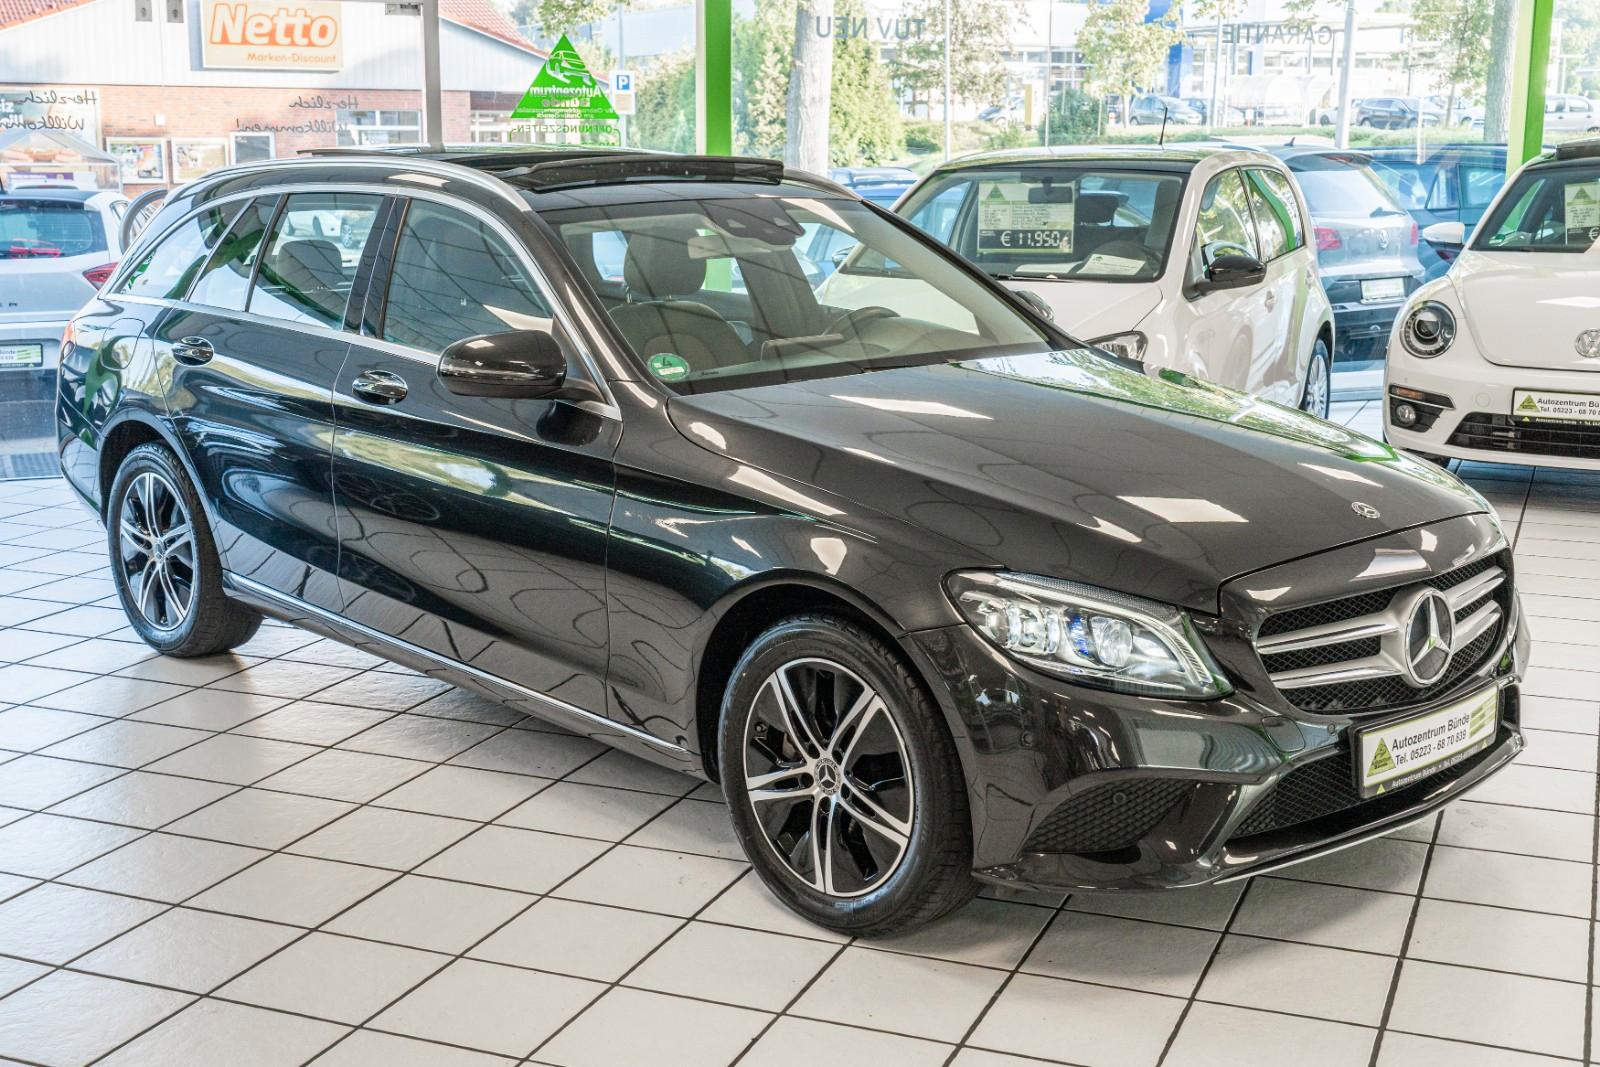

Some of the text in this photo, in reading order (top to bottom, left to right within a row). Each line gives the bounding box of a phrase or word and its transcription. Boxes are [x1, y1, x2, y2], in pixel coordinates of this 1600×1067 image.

[210, 3, 338, 47] Netto
[247, 52, 337, 64] Marken-Discount
[618, 75, 629, 89] P
[1001, 230, 1061, 247] € 11.950
[1537, 397, 1587, 408] Autozentrum
[1392, 713, 1470, 751] Autozentrum Bünde
[1395, 753, 1408, 766] Tel.
[1410, 743, 1432, 760] 05223
[1437, 738, 1446, 751] 68
[1446, 734, 1455, 747] 70
[1455, 729, 1467, 743] 839
